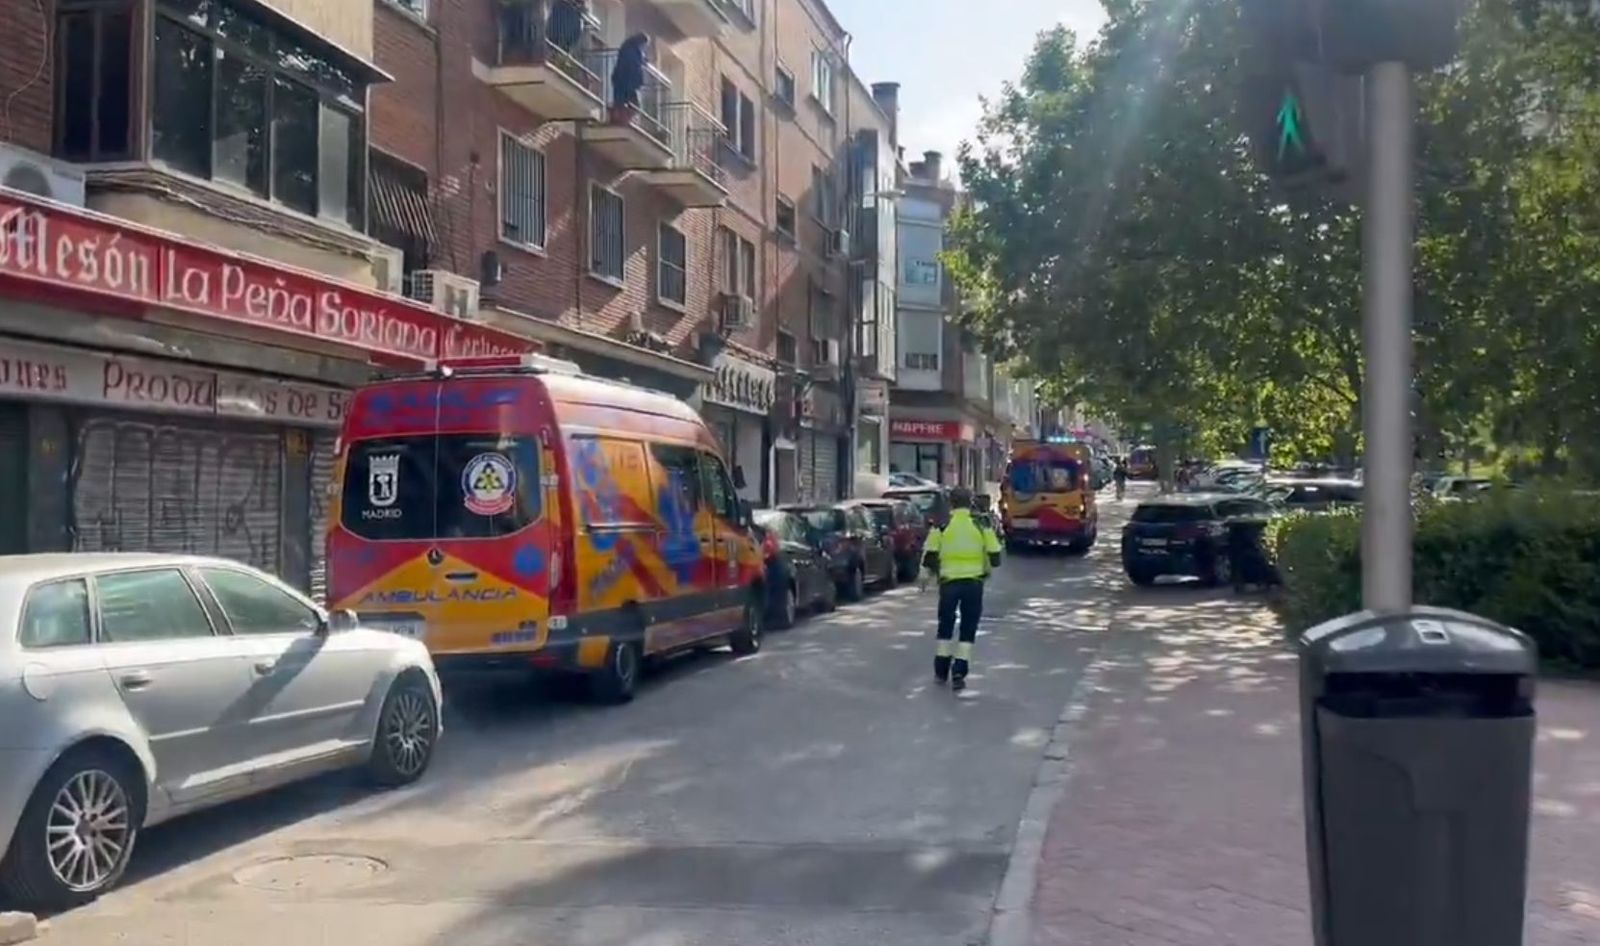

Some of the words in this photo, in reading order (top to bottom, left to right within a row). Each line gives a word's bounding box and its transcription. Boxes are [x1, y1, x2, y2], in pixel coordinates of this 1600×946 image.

[0, 206, 149, 297] Mesón
[167, 249, 209, 305] La
[222, 263, 312, 328] Peña
[318, 291, 437, 352] Soriana
[361, 508, 403, 520] MADRID
[359, 587, 518, 604] AMBULANCIA
